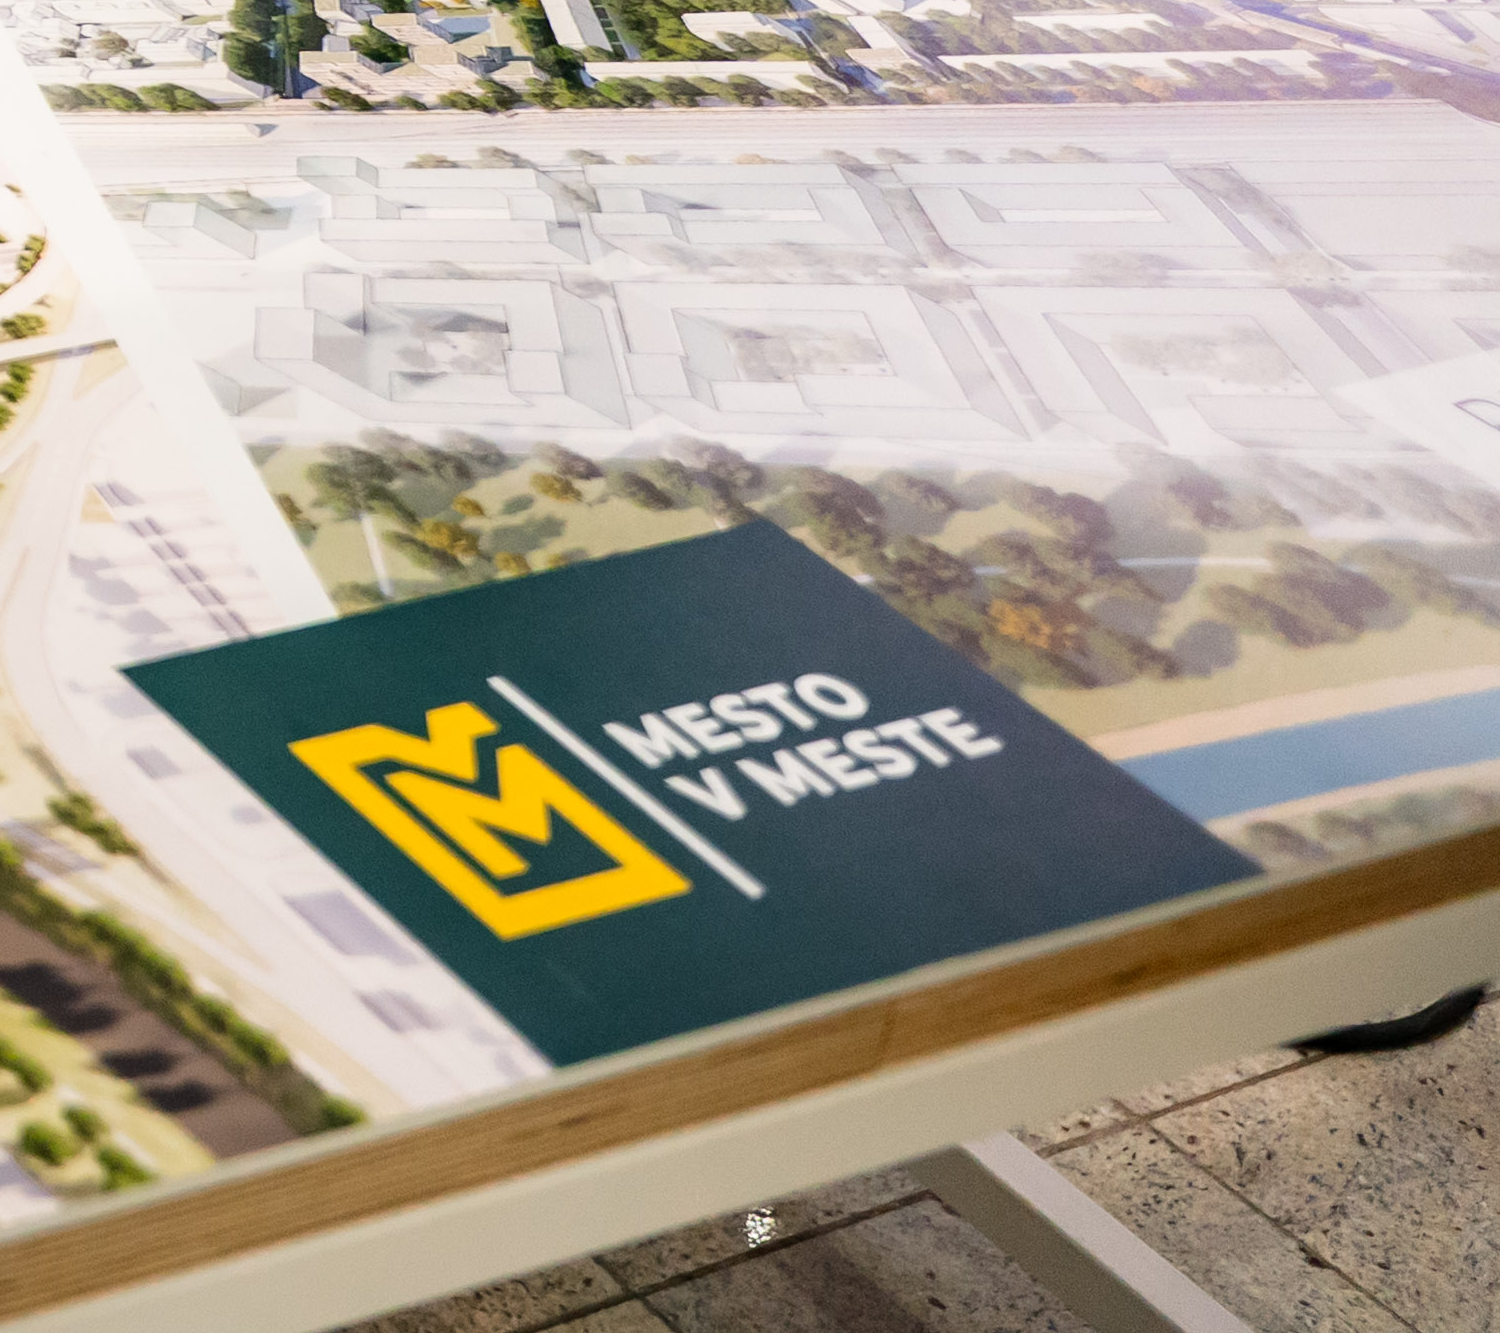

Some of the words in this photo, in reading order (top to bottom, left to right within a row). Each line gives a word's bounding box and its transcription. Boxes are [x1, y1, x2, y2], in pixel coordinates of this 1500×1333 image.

[602, 672, 870, 769] MESTO
[664, 767, 748, 821] V
[735, 707, 1003, 807] MESTE
